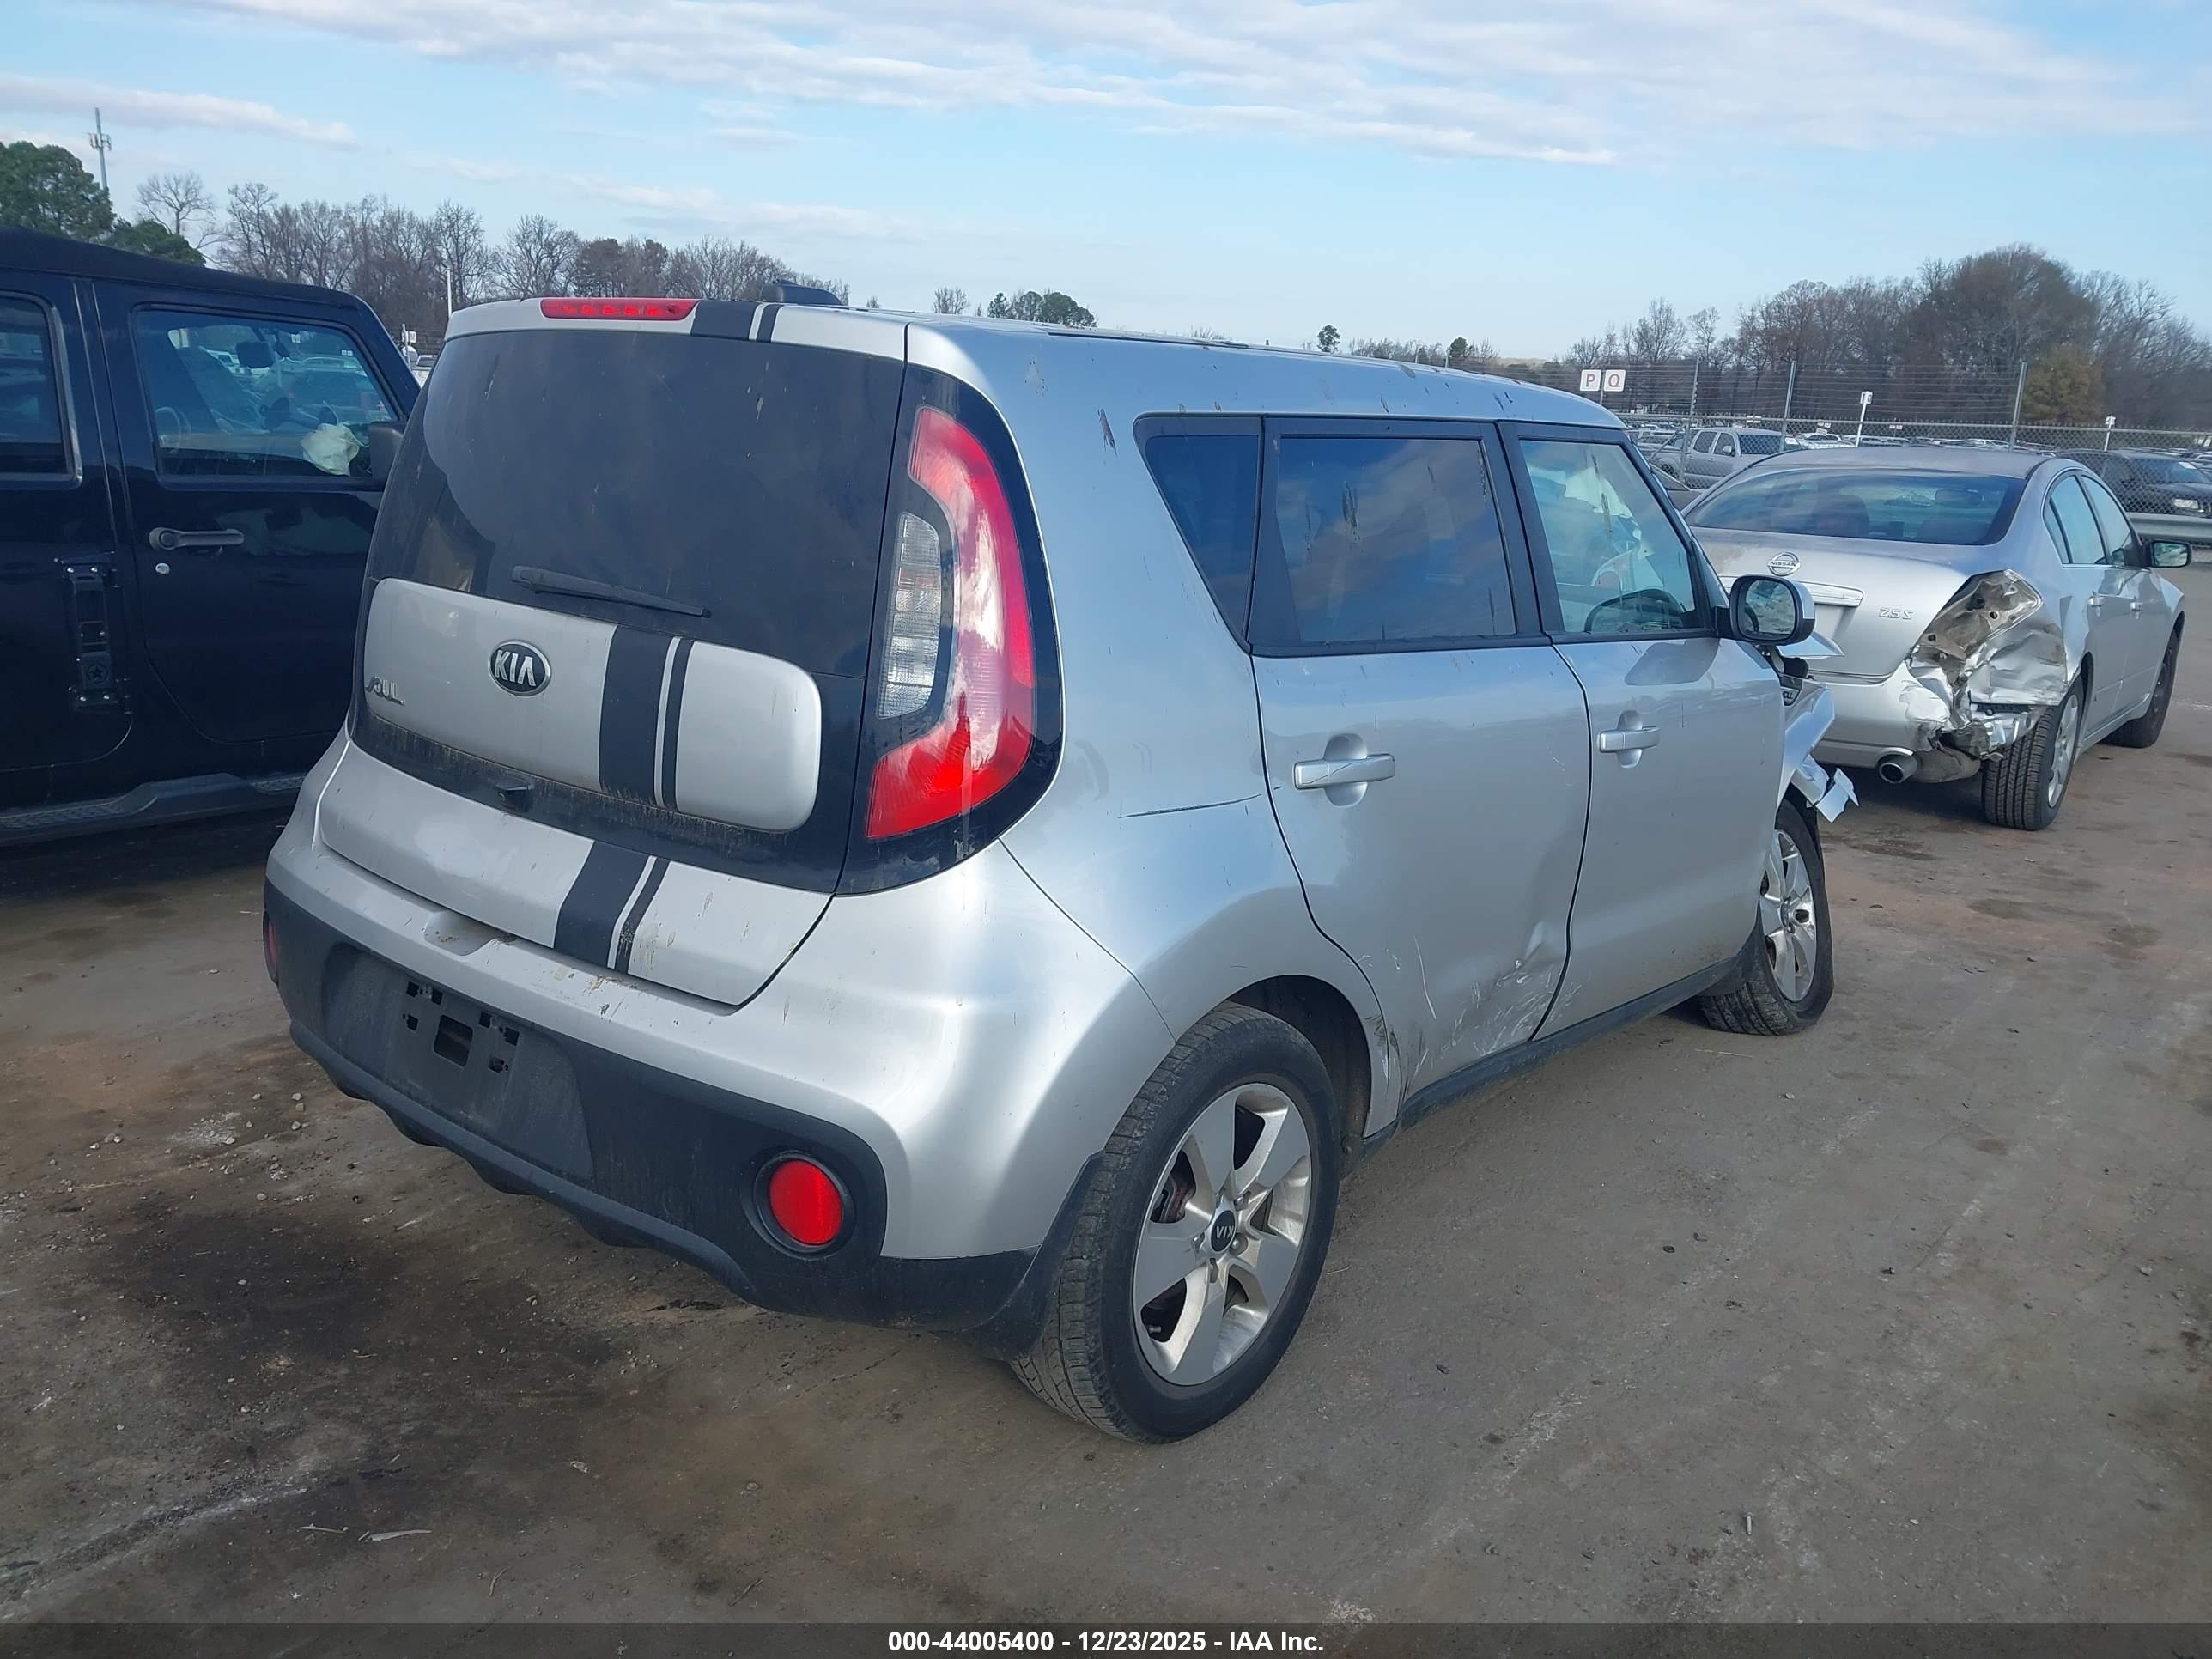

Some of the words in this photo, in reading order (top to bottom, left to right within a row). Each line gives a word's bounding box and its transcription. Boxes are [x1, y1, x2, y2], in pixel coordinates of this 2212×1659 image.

[1586, 374, 1595, 387] P
[1608, 374, 1620, 387] Q
[495, 649, 537, 687] KIA
